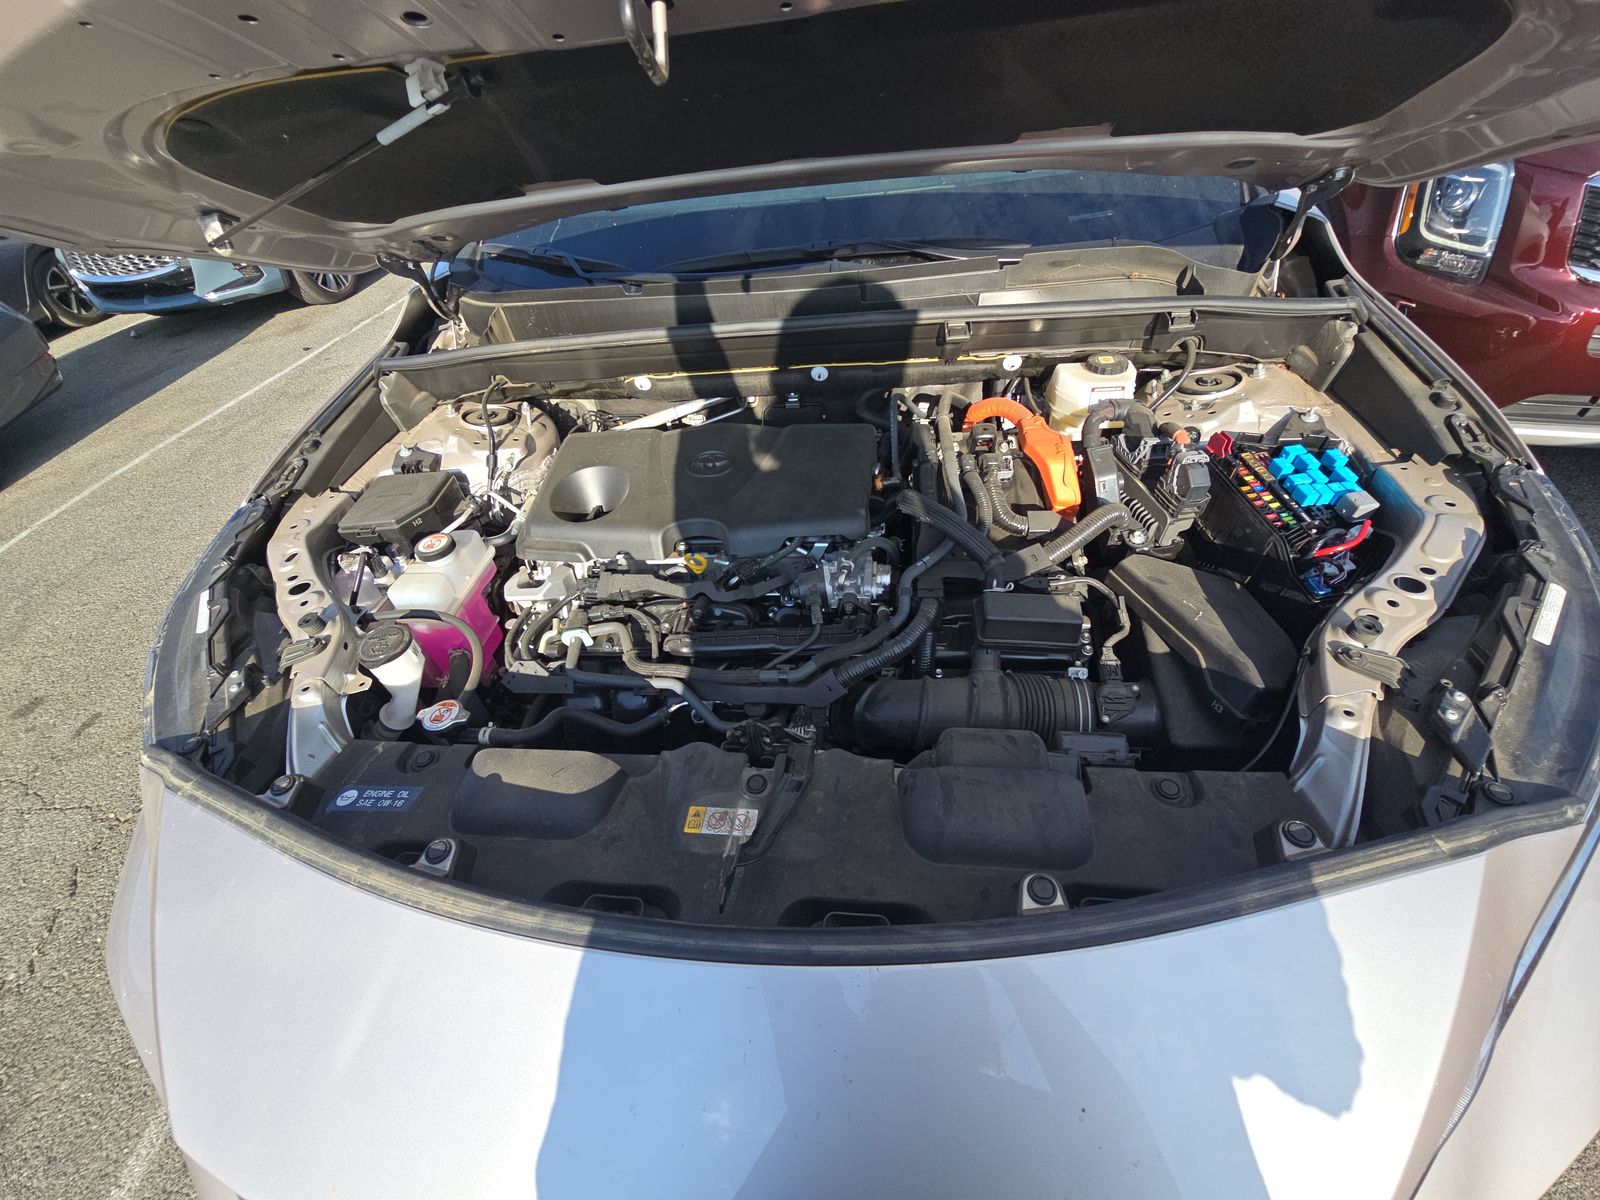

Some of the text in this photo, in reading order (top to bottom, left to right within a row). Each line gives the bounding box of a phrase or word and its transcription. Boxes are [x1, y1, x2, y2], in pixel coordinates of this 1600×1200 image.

[412, 518, 424, 527] H2
[1211, 700, 1224, 713] H3
[363, 790, 410, 798] ENGINE OIL
[356, 799, 404, 807] SAE 0W-16
